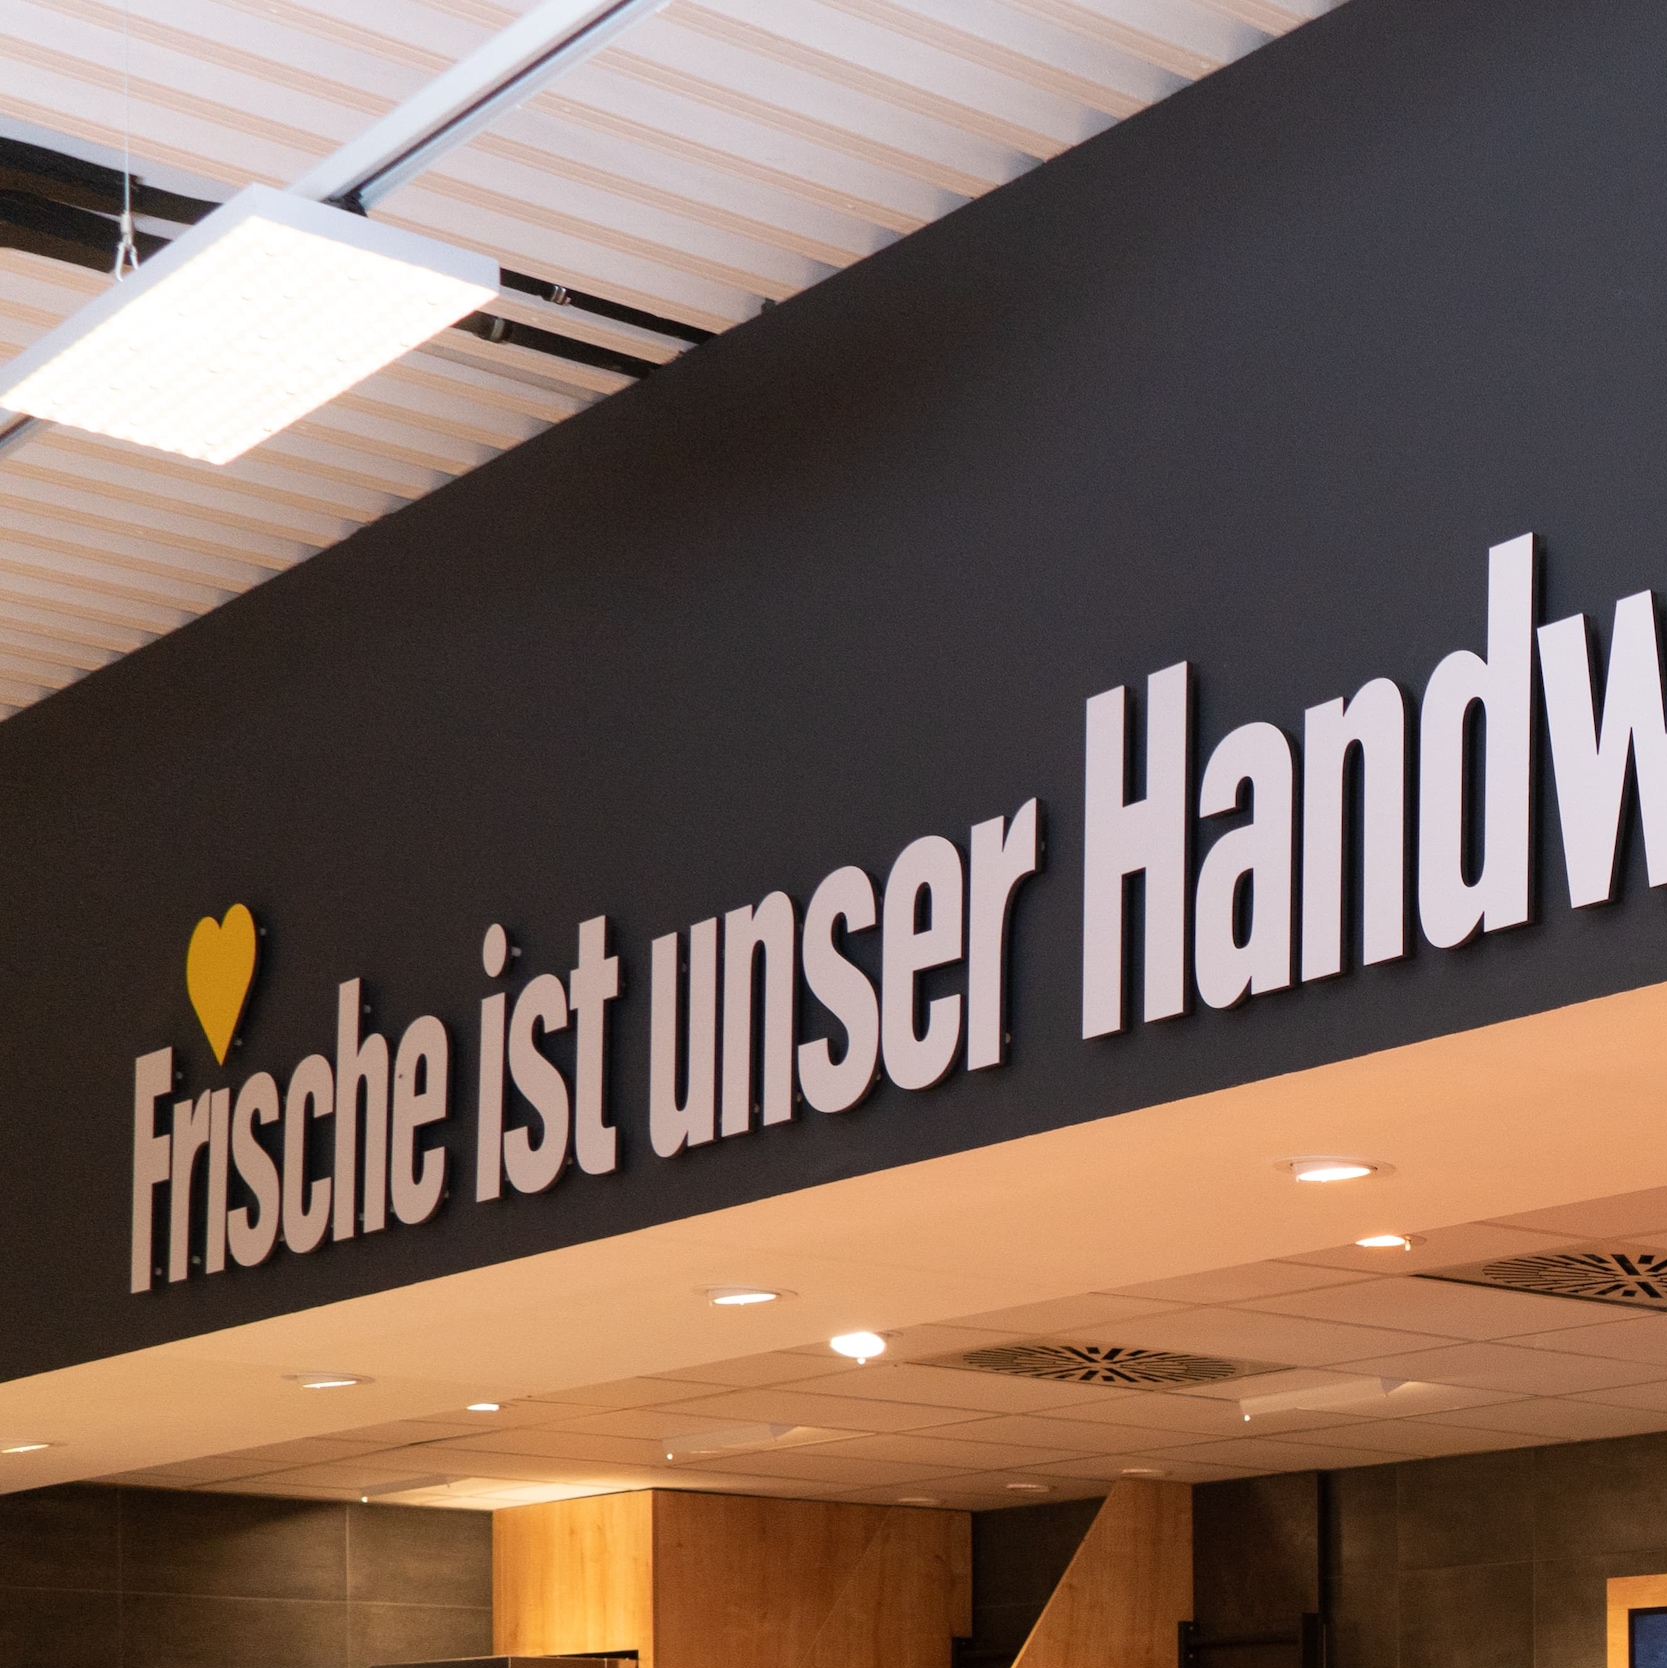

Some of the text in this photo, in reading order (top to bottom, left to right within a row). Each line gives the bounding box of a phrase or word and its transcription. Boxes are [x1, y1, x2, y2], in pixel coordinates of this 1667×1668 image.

[131, 978, 449, 1292] Frische
[476, 914, 616, 1202] ist
[648, 797, 1038, 1159] unser
